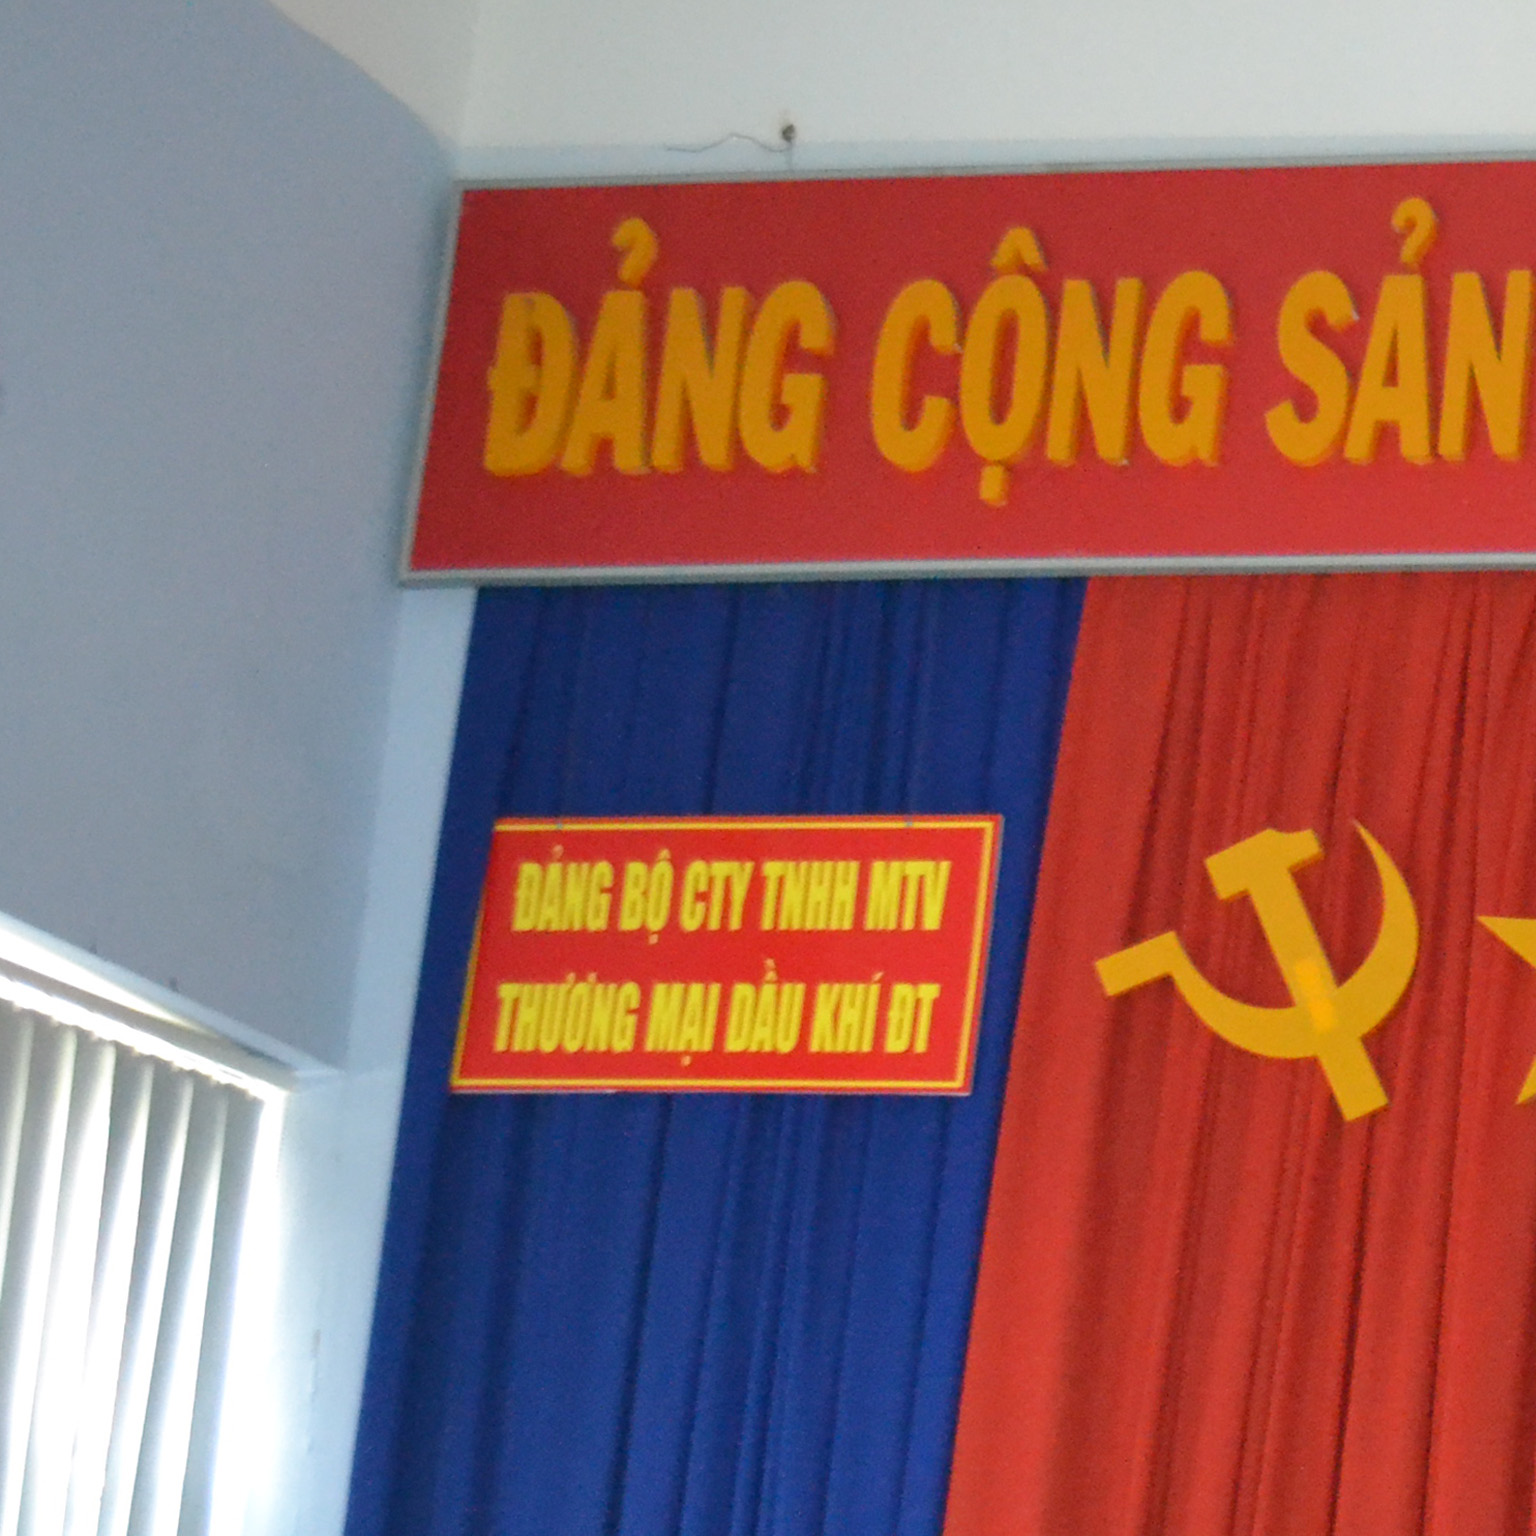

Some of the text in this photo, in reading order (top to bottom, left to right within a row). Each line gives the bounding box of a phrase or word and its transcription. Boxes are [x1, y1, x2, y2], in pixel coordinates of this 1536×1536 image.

[483, 218, 833, 474] ĐẢNG
[871, 227, 1231, 505] CỘNG
[1264, 197, 1534, 467] SẢN
[511, 844, 953, 945] ĐẢNG BỘ CTY TNHH MTV
[643, 981, 722, 1067] MẠI
[808, 970, 884, 1054] KHÍ
[884, 981, 943, 1054] ĐT
